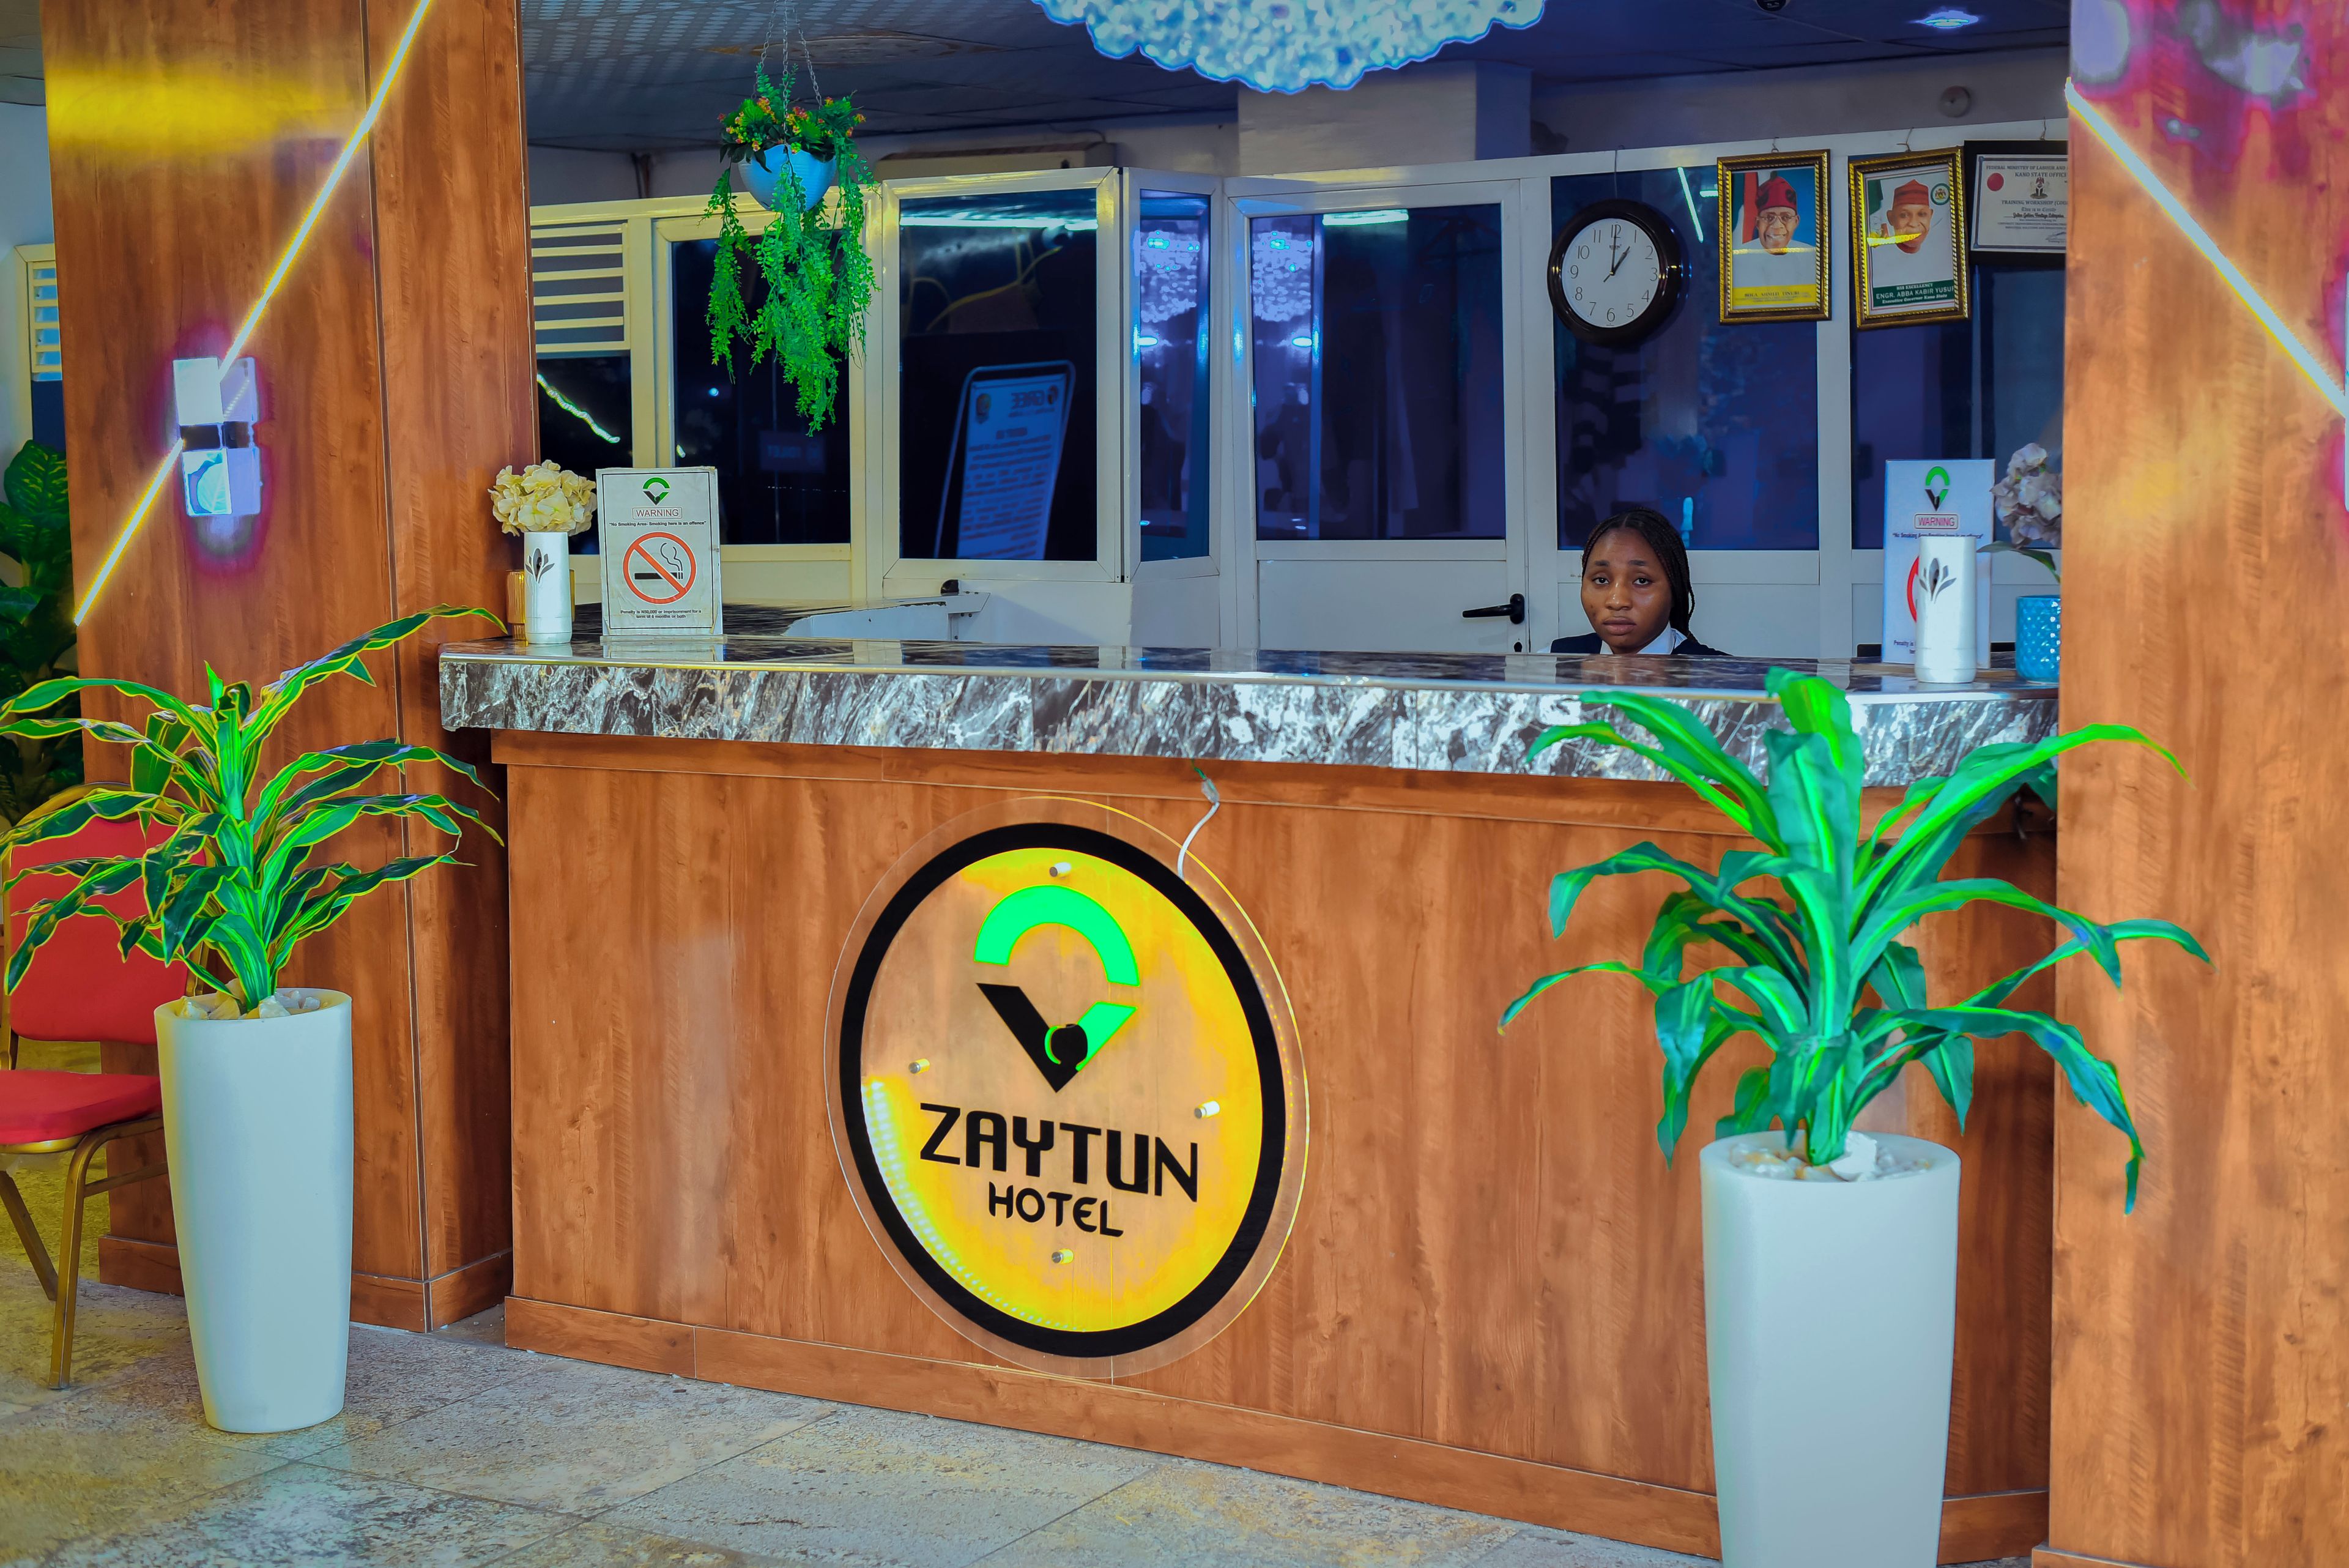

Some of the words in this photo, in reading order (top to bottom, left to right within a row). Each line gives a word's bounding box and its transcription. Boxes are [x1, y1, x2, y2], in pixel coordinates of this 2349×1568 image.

[1594, 229, 1601, 243] 11
[1577, 245, 1590, 259] 10
[1645, 246, 1653, 259] 2
[1570, 265, 1579, 279] 9
[1650, 267, 1658, 281] 3
[1575, 286, 1583, 301] 8
[1641, 289, 1650, 303] 4
[1589, 302, 1597, 316] 7
[1606, 308, 1616, 322] 6
[1626, 303, 1635, 317] 5
[1918, 517, 1954, 526] WARNING
[919, 1102, 1198, 1203] ZAYTUN
[989, 1181, 1124, 1238] HOTEL
